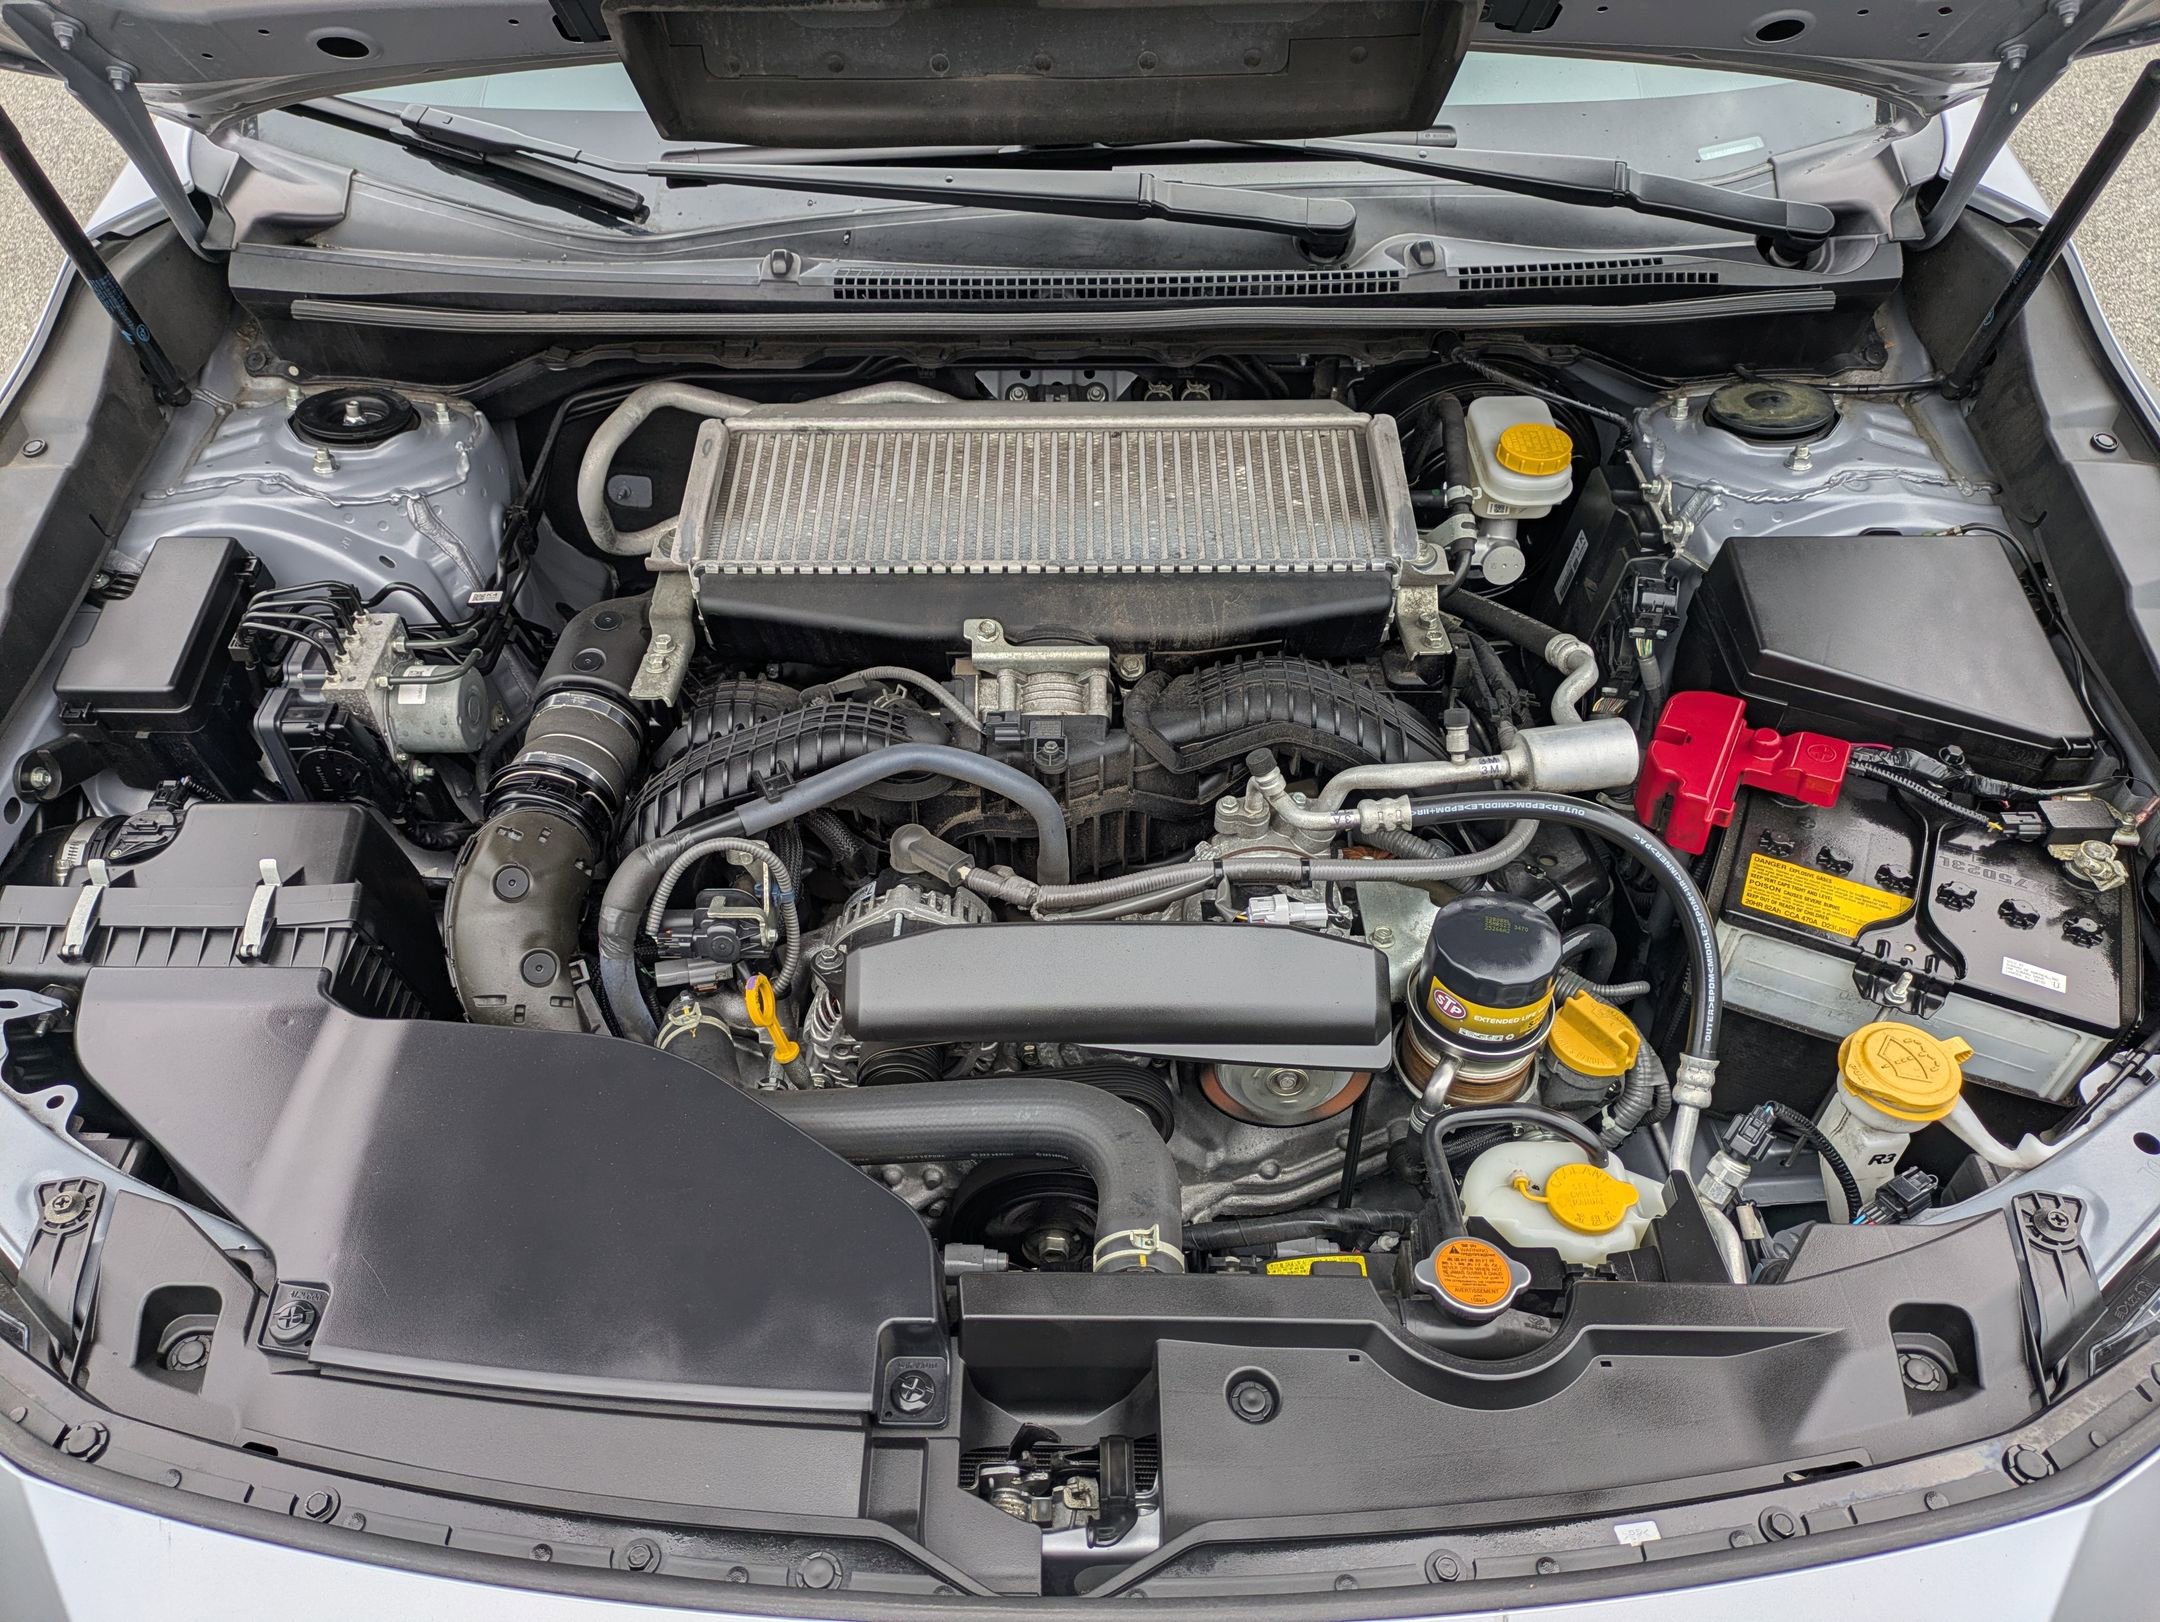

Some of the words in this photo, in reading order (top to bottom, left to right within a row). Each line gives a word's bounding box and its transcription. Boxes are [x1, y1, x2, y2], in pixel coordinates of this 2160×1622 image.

[1754, 857, 1786, 870] DANGER
[1788, 867, 1814, 878] EXPLOSIVE
[1748, 879, 1781, 893] POISON
[1782, 890, 1802, 899] CAUSES
[1744, 898, 1763, 908] 20HR
[1783, 910, 1800, 920] CCA
[1436, 993, 1463, 1015] STP
[1474, 1014, 1519, 1025] EXTENDED
[1867, 1153, 1897, 1166] R3
